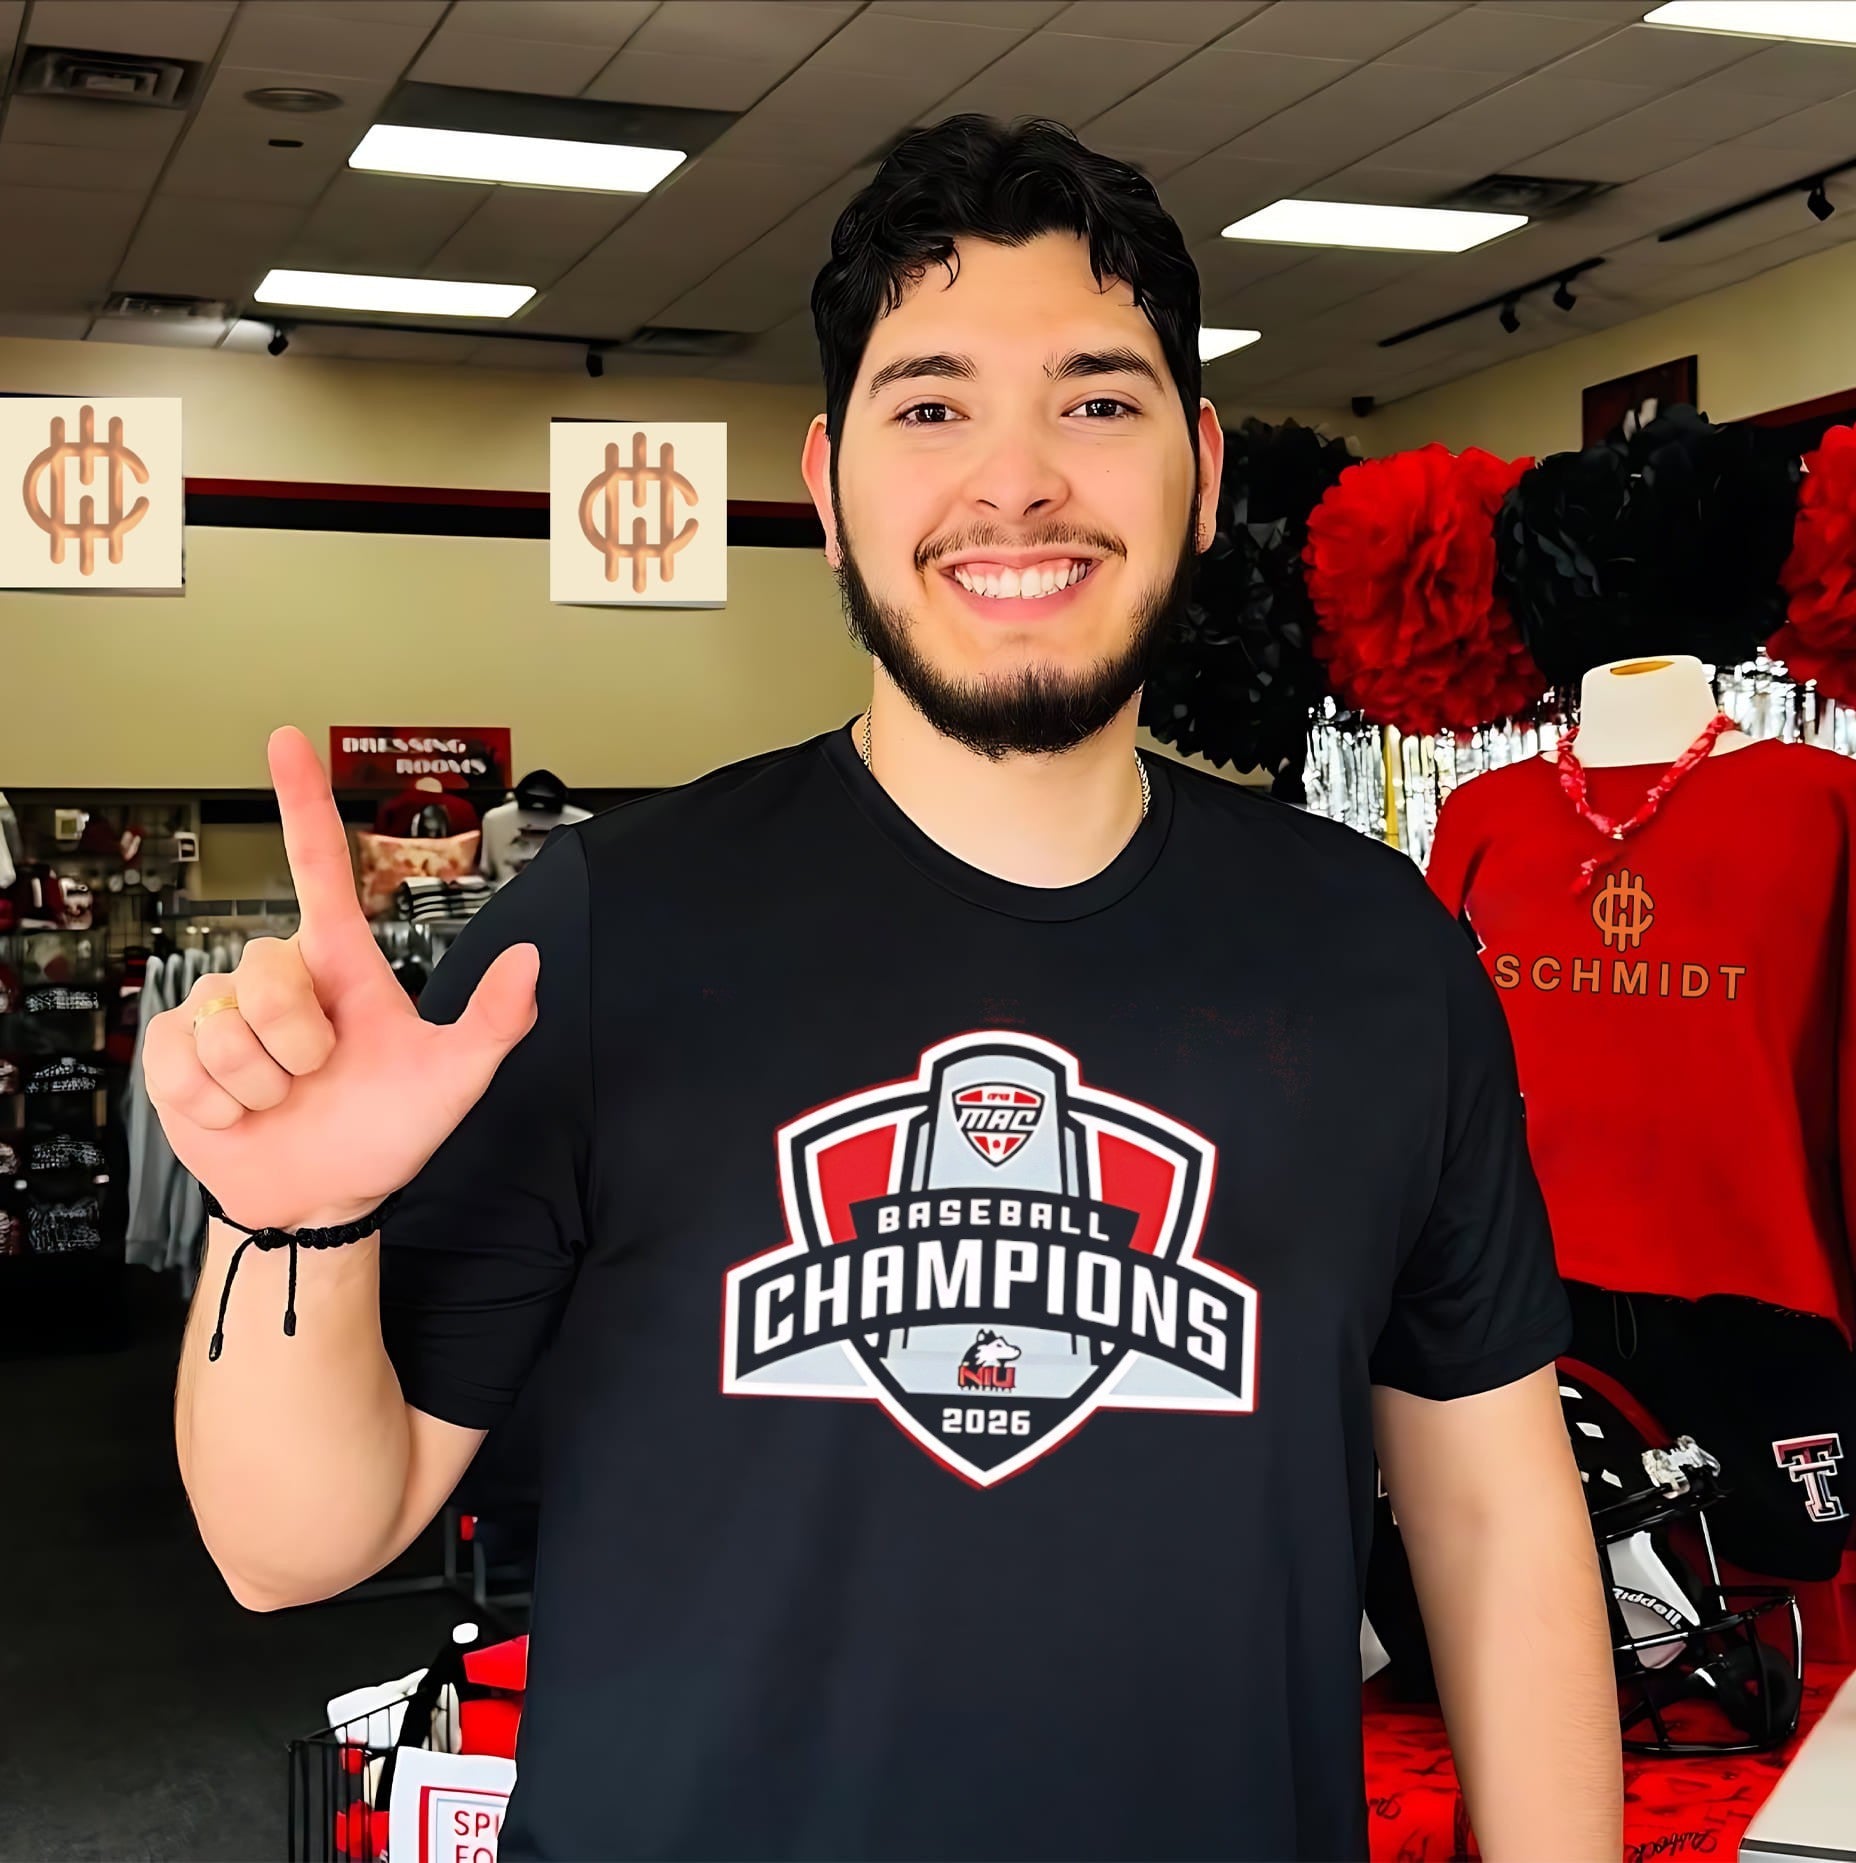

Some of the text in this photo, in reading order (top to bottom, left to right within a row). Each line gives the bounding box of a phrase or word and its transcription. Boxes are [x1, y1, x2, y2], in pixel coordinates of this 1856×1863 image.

[1494, 954, 1746, 1000] SCHMIDT
[957, 1108, 1038, 1132] MAC
[878, 1199, 1110, 1241] BASEBALL
[754, 1239, 1228, 1371] CHAMPIONS
[958, 1364, 1016, 1389] NIU
[942, 1407, 1031, 1436] 2026
